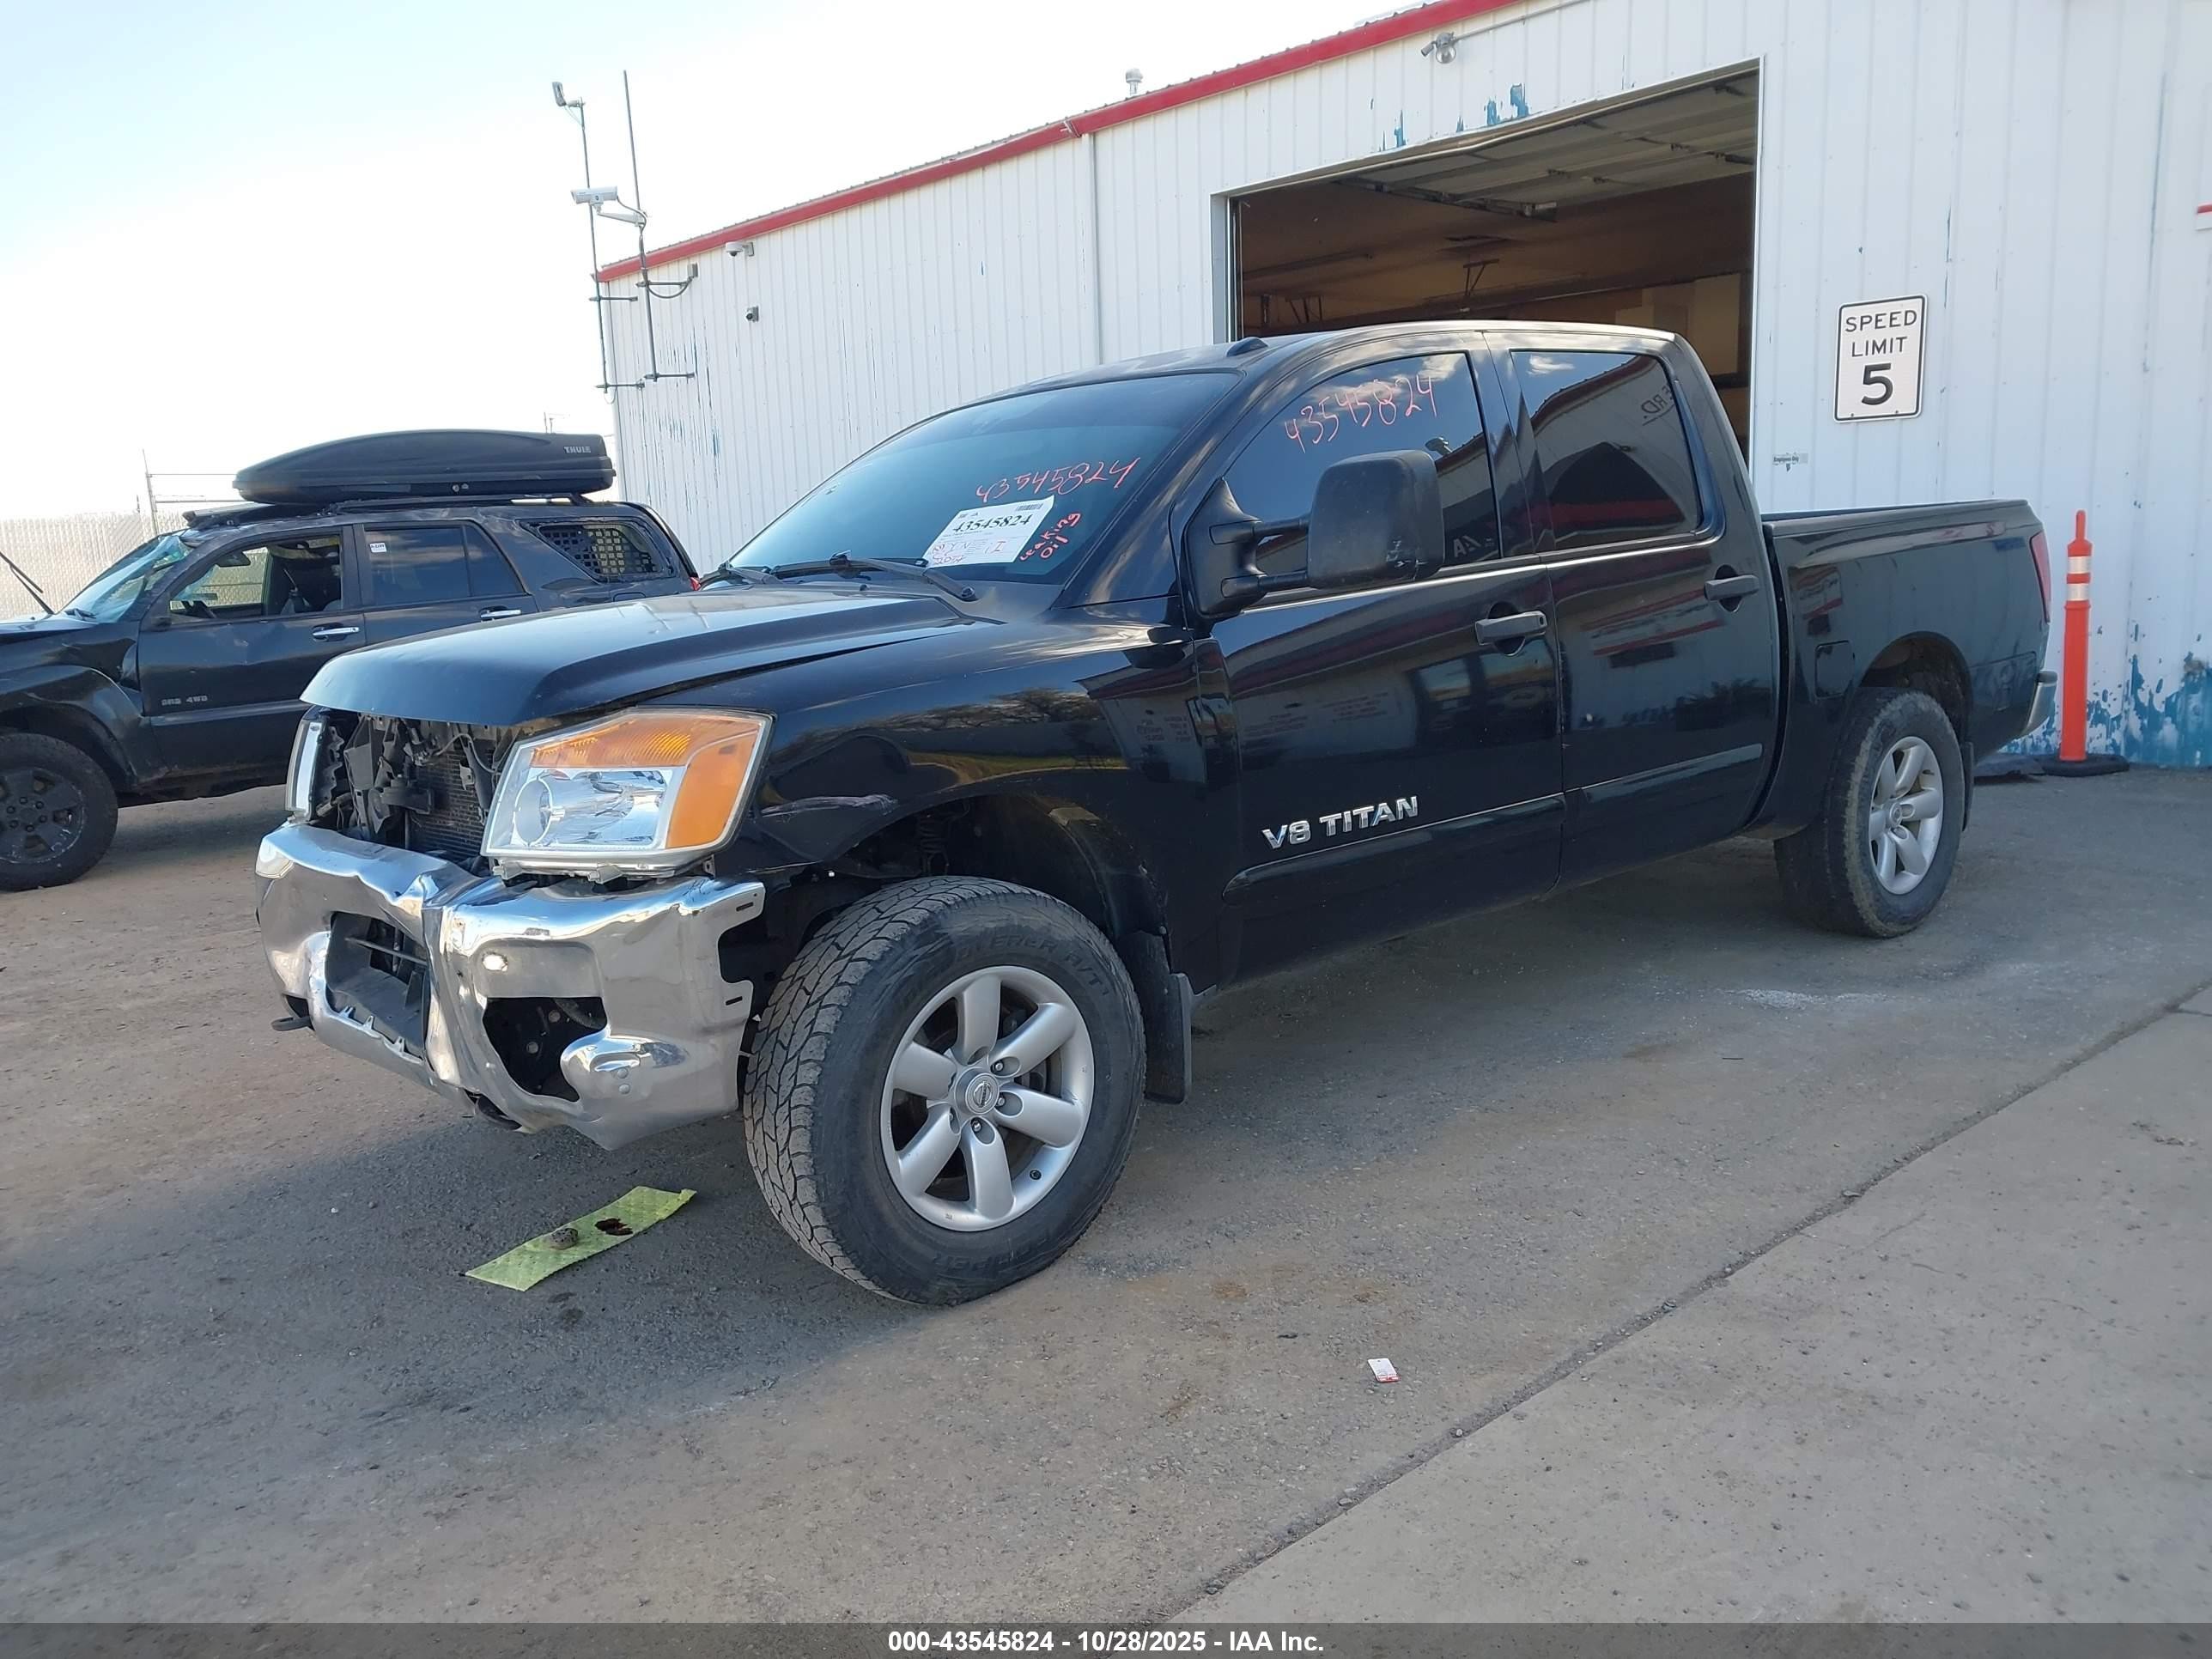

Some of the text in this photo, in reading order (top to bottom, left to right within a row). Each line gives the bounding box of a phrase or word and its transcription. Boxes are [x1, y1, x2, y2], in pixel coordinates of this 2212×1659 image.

[1844, 310, 1917, 332] SPEED
[1851, 336, 1908, 357] LIMIT
[1861, 362, 1894, 406] 5
[1285, 374, 1437, 453] 43545824
[975, 457, 1141, 503] 43545824
[952, 514, 1034, 532] 43545824
[1261, 795, 1419, 849] V8 TITAN
